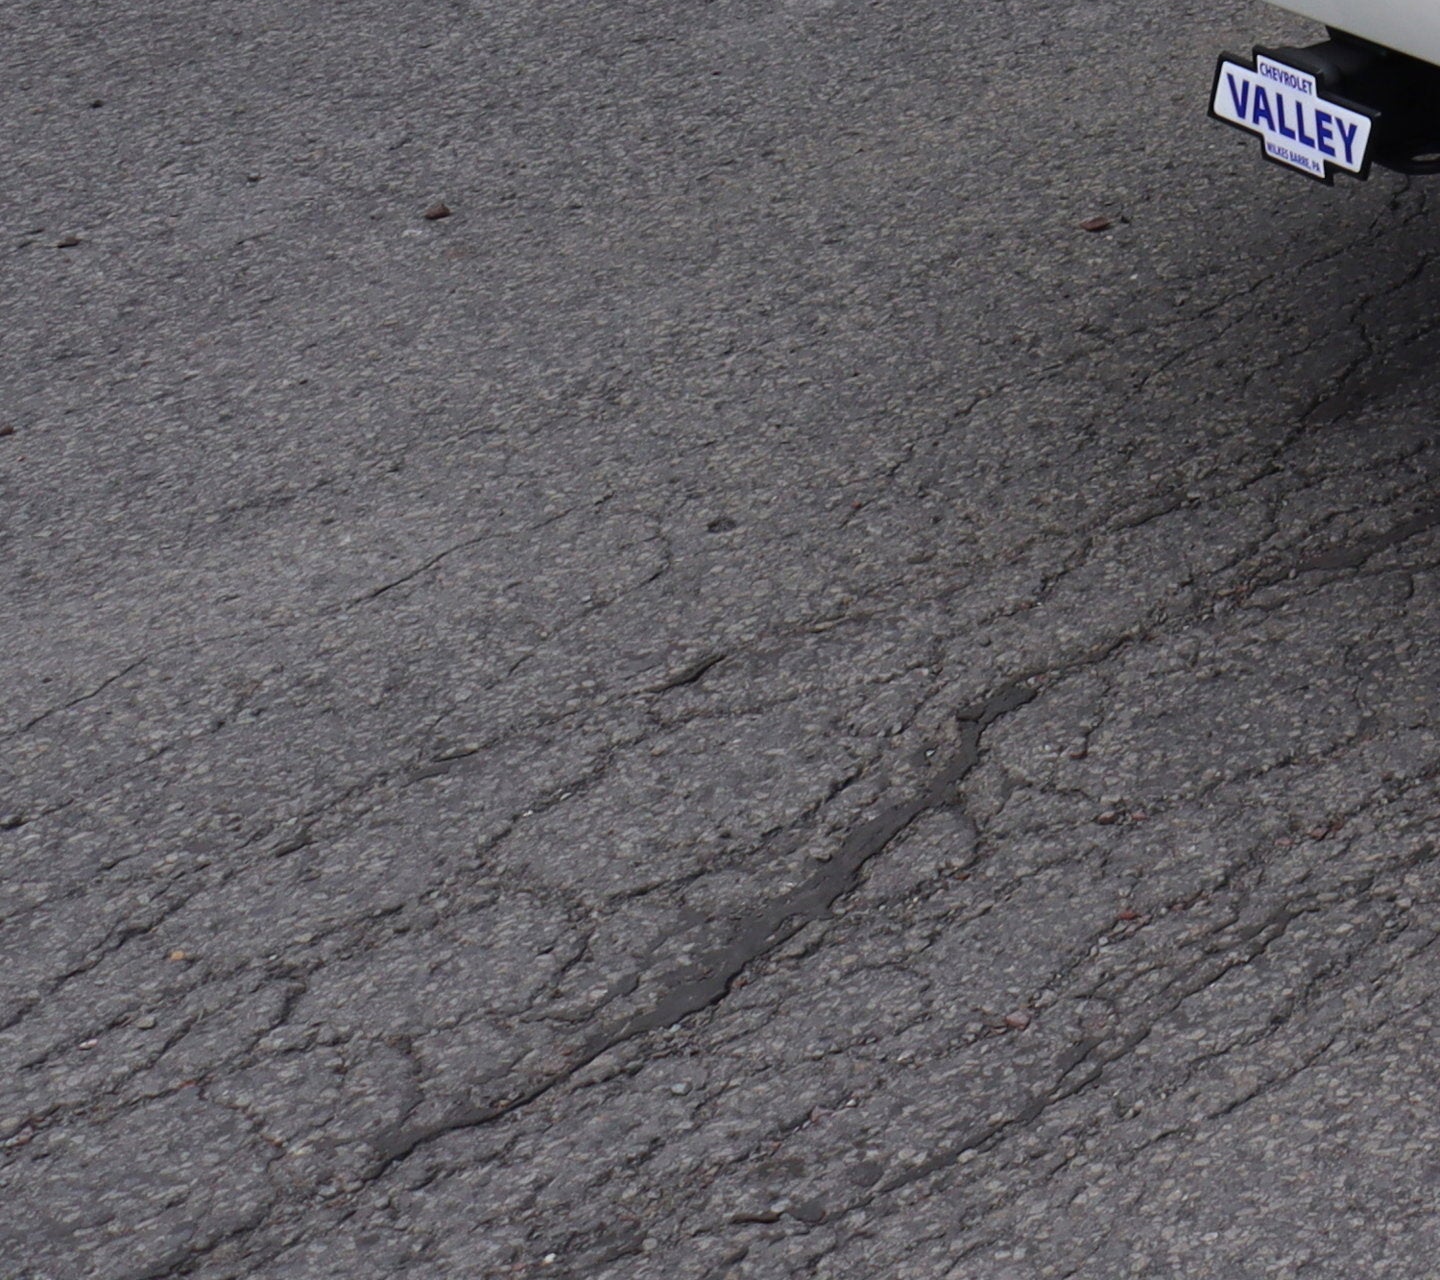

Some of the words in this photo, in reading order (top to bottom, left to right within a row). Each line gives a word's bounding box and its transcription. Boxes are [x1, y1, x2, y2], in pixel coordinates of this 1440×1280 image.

[1259, 61, 1313, 96] CHEVROLET
[1226, 72, 1358, 166] VALLEY
[1266, 142, 1289, 160] WILKES
[1311, 161, 1321, 173] PA
